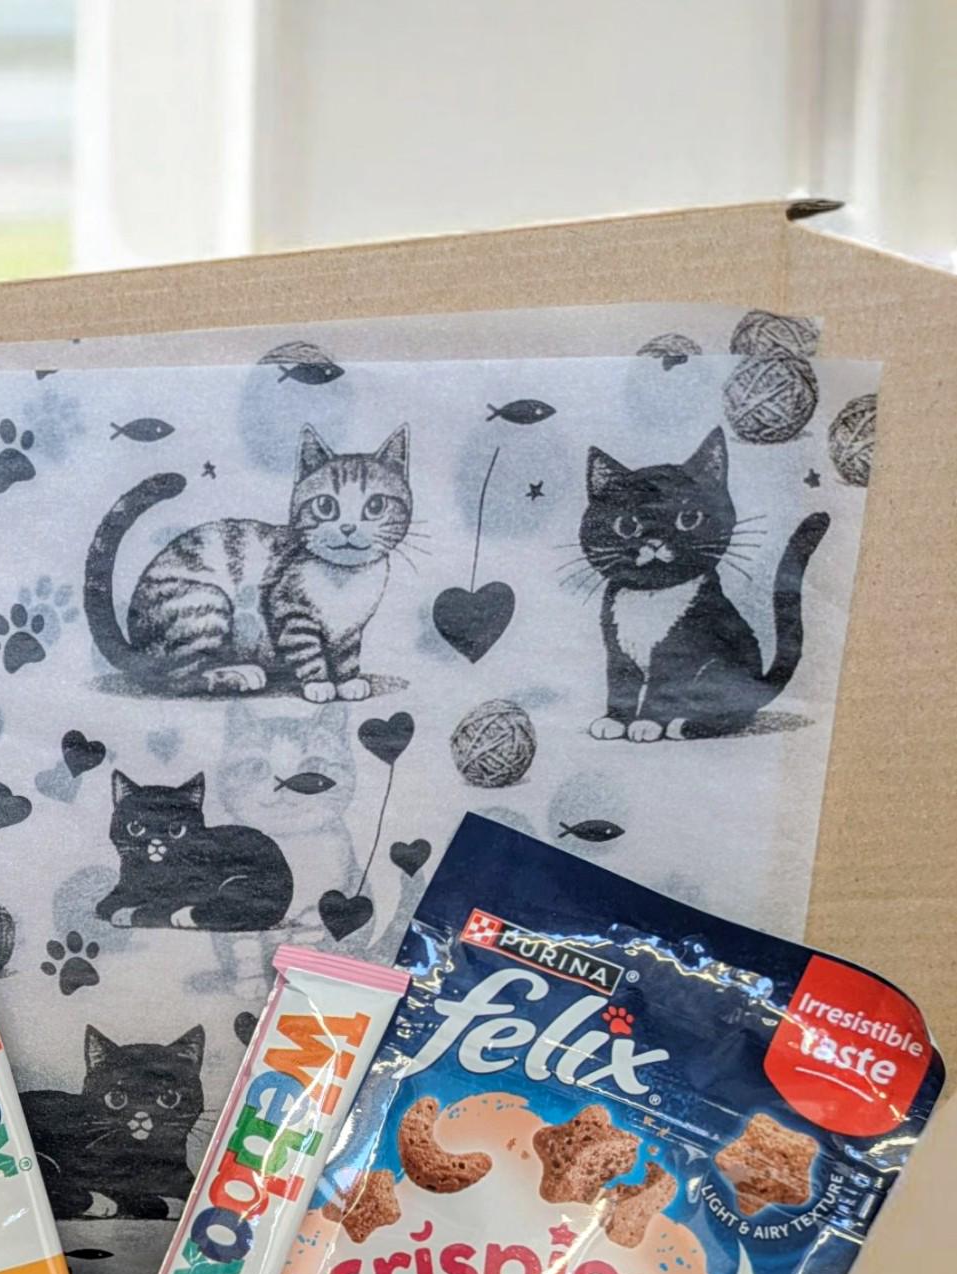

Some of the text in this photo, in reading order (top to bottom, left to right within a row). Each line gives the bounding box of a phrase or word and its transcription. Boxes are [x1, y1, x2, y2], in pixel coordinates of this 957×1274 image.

[501, 928, 609, 988] PURINA
[392, 968, 670, 1094] felix
[797, 991, 925, 1059] Irresistible
[800, 1026, 898, 1085] taste
[701, 1173, 845, 1239] LIGHT & AIRY TEXTURE
